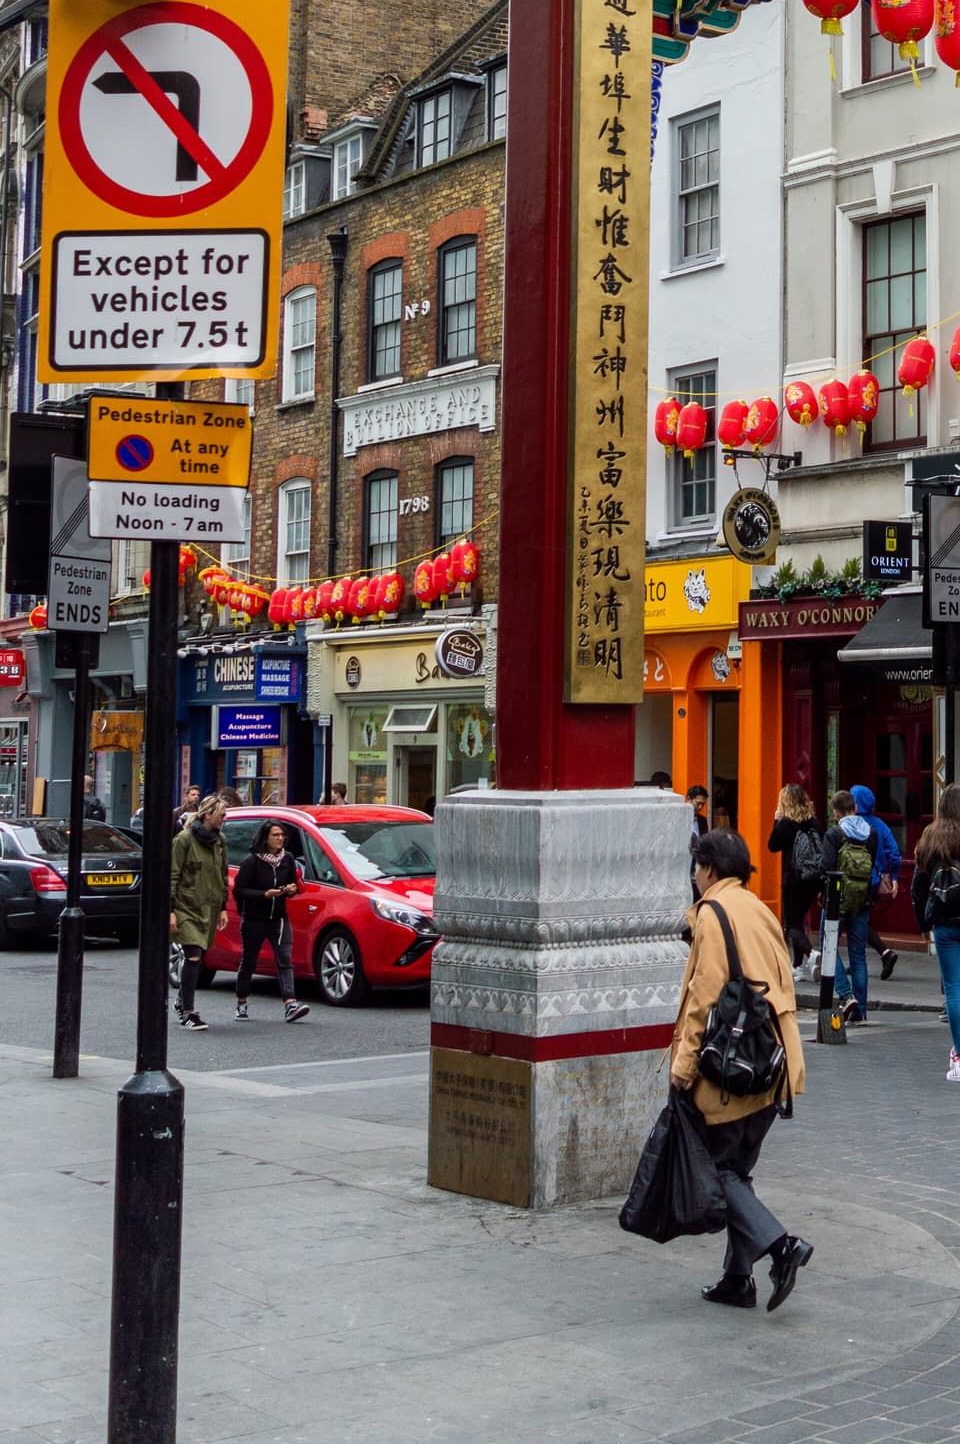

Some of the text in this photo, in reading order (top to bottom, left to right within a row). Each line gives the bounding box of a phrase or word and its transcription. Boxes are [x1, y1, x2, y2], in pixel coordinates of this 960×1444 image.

[73, 247, 249, 280] Except for
[91, 285, 227, 312] vehicles
[69, 322, 163, 349] under
[353, 386, 481, 428] EXCHANGE AND
[98, 406, 246, 429] Pedestrian Zone
[346, 404, 488, 445] BULLION OFFICE
[171, 438, 229, 457] At any
[180, 458, 220, 474] time
[121, 491, 220, 511] No loading
[399, 495, 430, 515] 1798
[116, 514, 164, 531] Noon
[871, 556, 910, 567] ORIENT
[54, 562, 107, 581] Pedestrian
[67, 581, 92, 596] Zone
[56, 602, 101, 625] ENDS
[746, 610, 790, 628] WAXY
[214, 656, 254, 682] CHINESE
[261, 674, 290, 682] MASSAGE
[236, 713, 264, 721] Massage
[228, 723, 272, 731] Acupuncture
